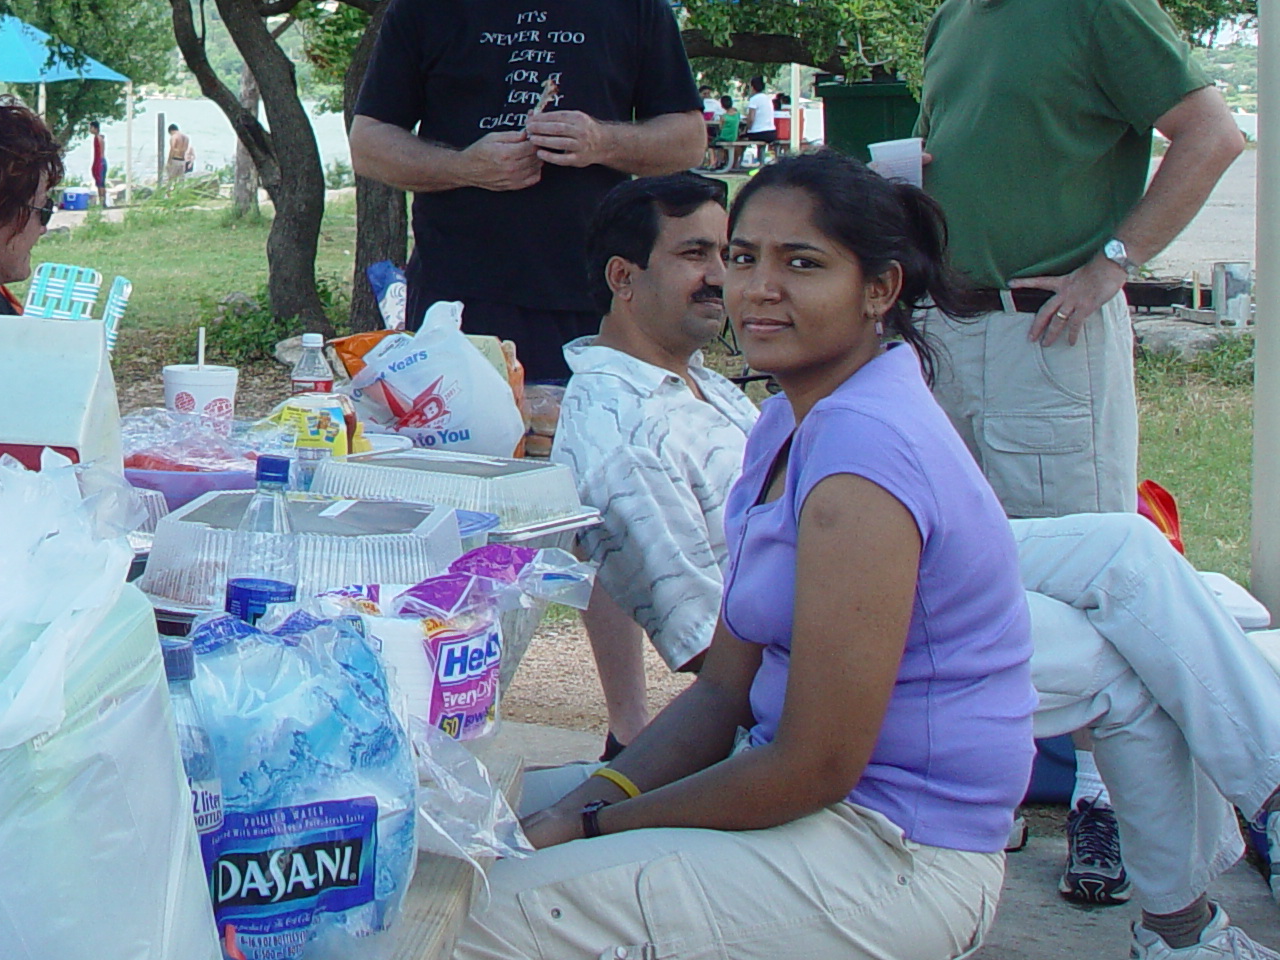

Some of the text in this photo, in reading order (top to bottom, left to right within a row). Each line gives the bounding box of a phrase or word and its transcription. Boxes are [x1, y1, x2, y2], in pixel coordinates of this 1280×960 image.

[516, 10, 548, 25] IT'S
[479, 30, 585, 46] NEVER TOO
[508, 49, 556, 64] LATE
[388, 349, 428, 373] Years
[416, 428, 472, 447] to You
[442, 716, 459, 737] 50
[291, 805, 324, 820] WATER
[218, 845, 353, 904] DASANI
